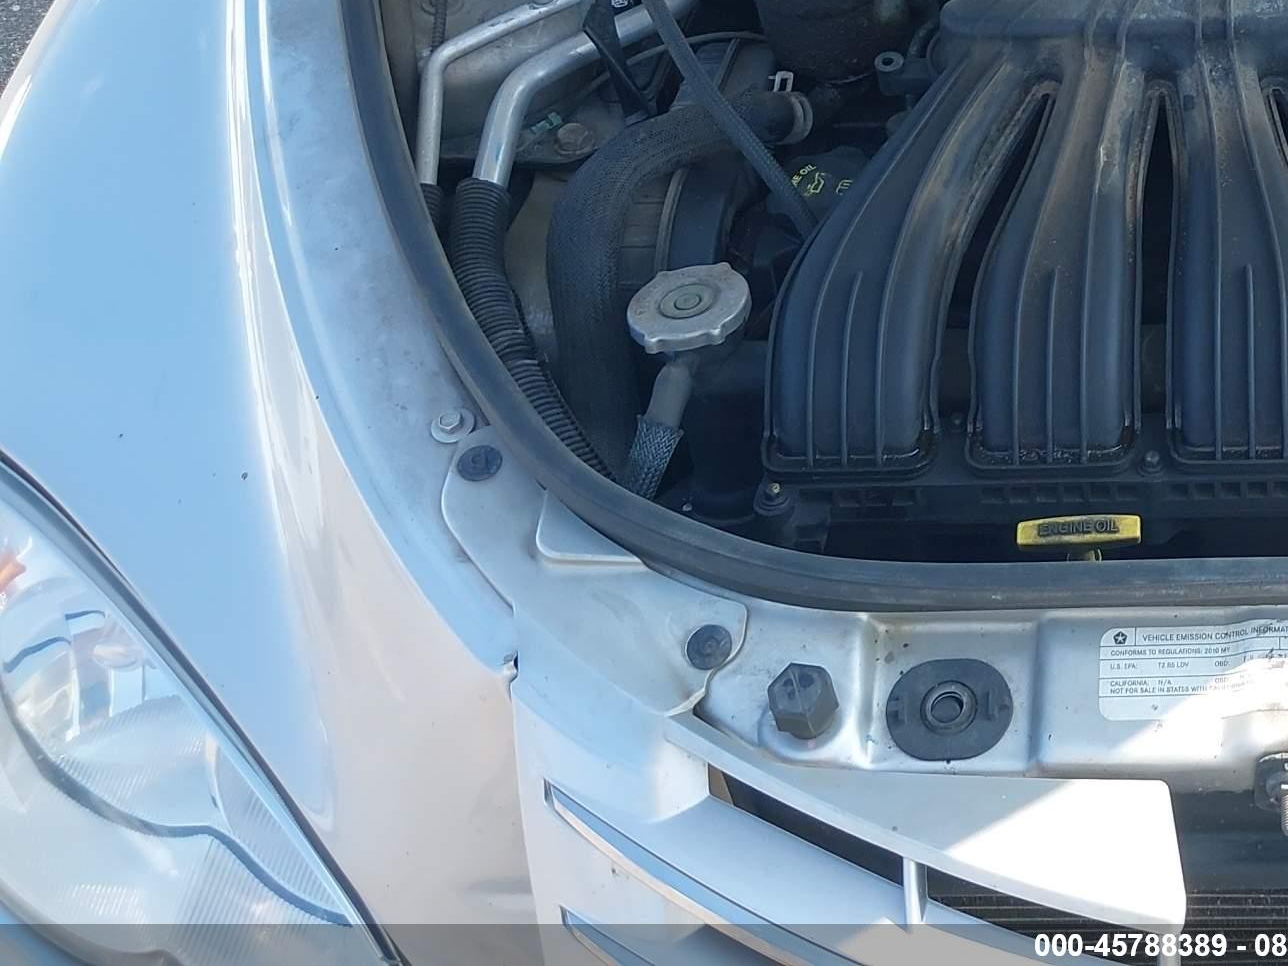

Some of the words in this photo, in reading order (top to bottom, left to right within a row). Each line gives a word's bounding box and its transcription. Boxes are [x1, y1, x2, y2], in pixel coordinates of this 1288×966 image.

[1039, 520, 1093, 536] ENGINE
[1094, 519, 1119, 533] OIL
[1142, 633, 1175, 642] VEHICLE
[1176, 632, 1213, 641] EMISSION
[1215, 630, 1248, 640] CONTROL
[1110, 648, 1147, 656] CONFORMS
[1148, 648, 1157, 656] TO
[1204, 647, 1220, 655] 2010
[1221, 646, 1231, 654] MY
[1110, 687, 1124, 695] NOT
